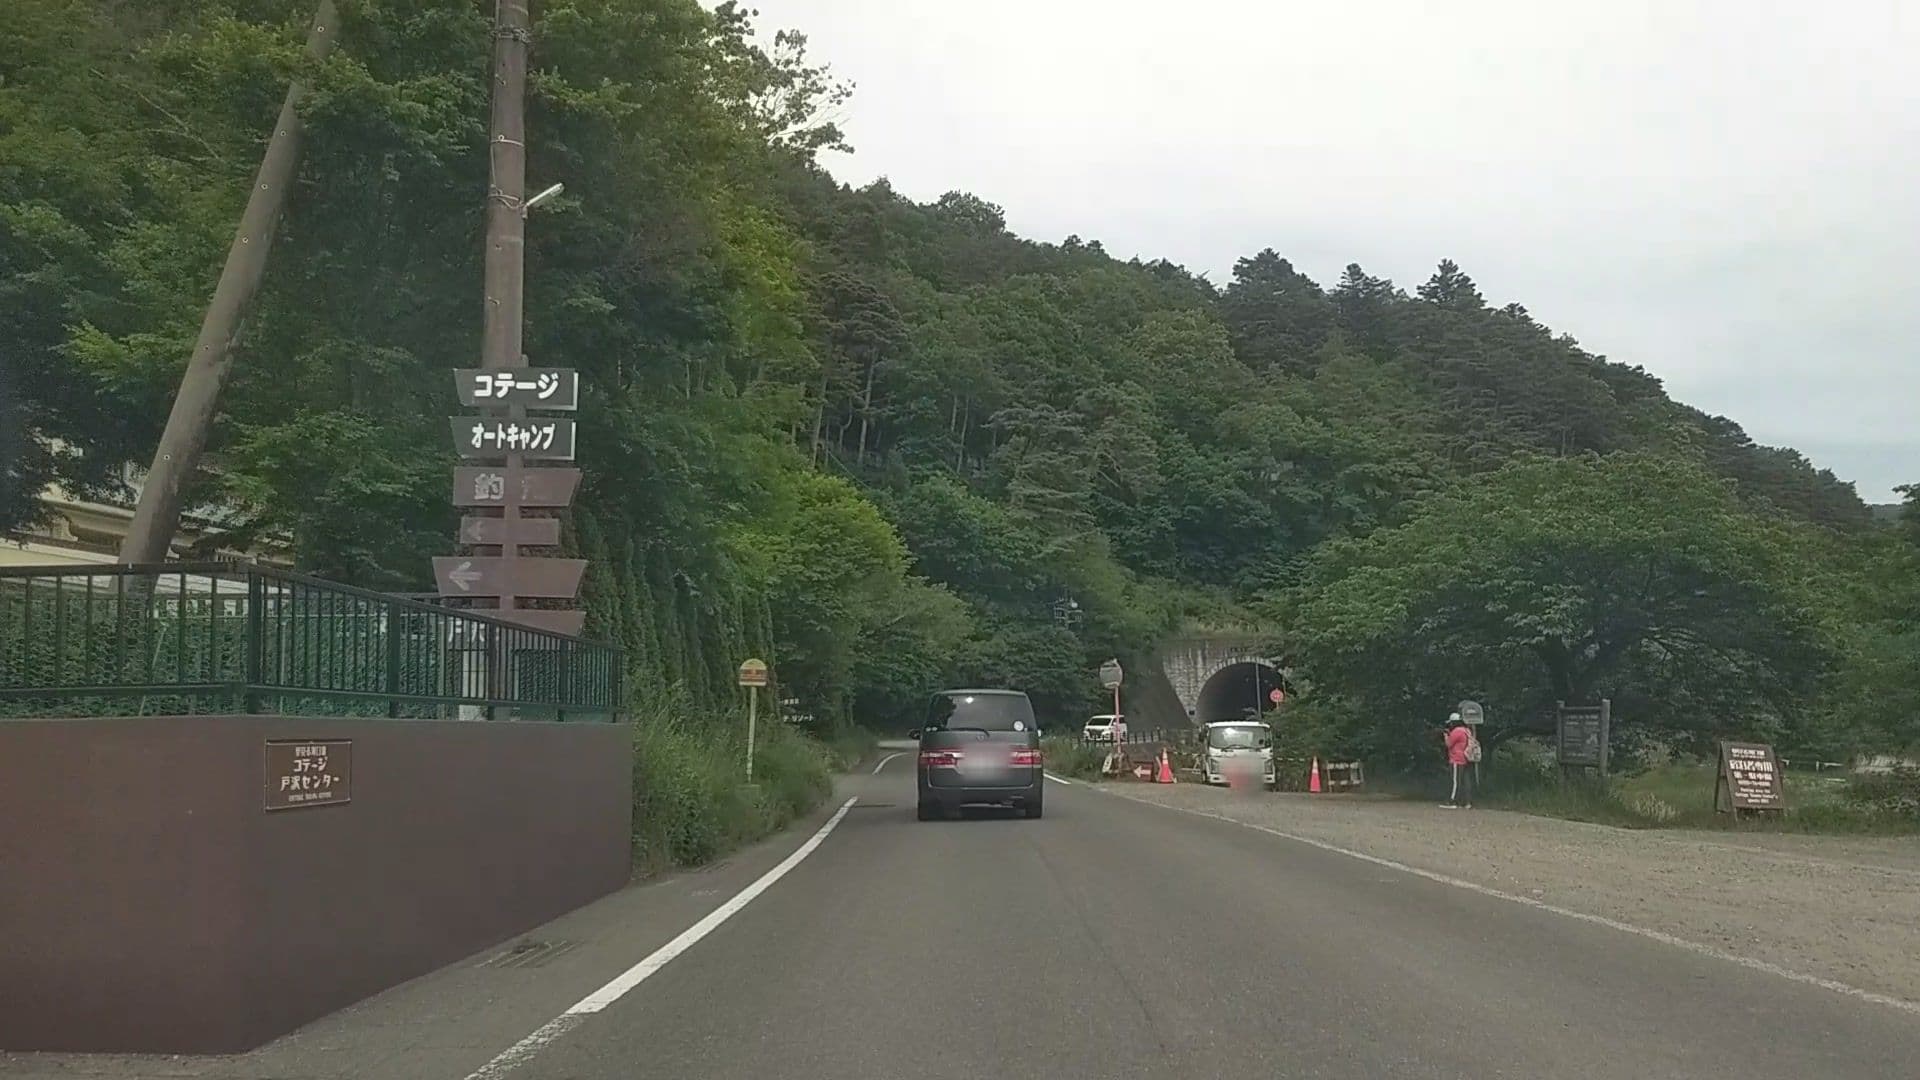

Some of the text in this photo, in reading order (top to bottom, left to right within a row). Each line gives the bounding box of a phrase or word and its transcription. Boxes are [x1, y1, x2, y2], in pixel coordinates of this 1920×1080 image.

[474, 372, 559, 400] コテージ
[471, 422, 556, 450] オートキャンプ
[293, 756, 328, 772] コテージ
[280, 774, 340, 791] 戸沢センター
